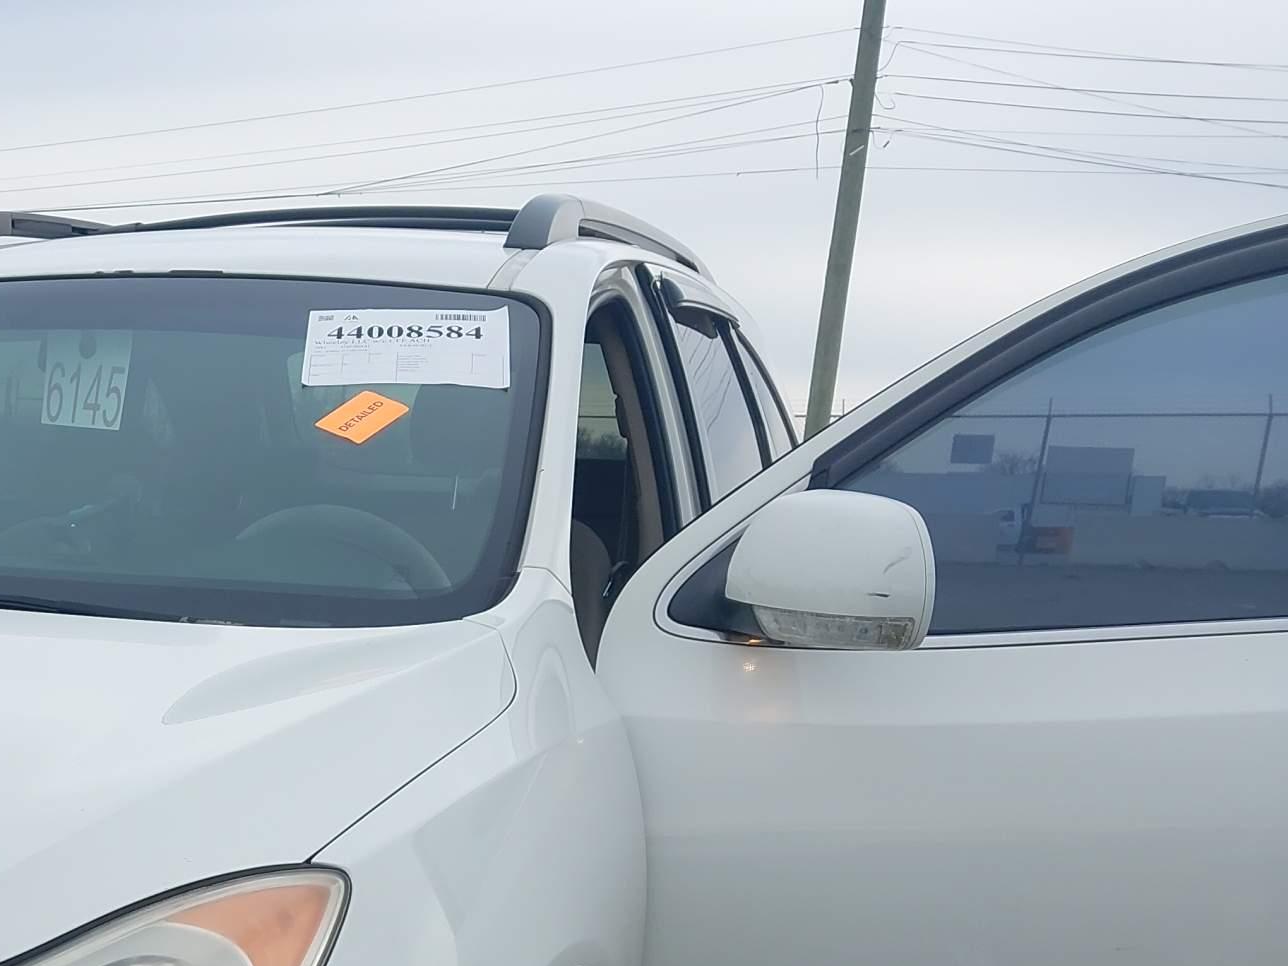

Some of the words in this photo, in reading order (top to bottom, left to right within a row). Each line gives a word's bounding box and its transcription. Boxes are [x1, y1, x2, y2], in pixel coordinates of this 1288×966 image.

[328, 325, 483, 340] 44008584
[47, 362, 126, 427] 6145
[338, 400, 384, 432] DETAILED
